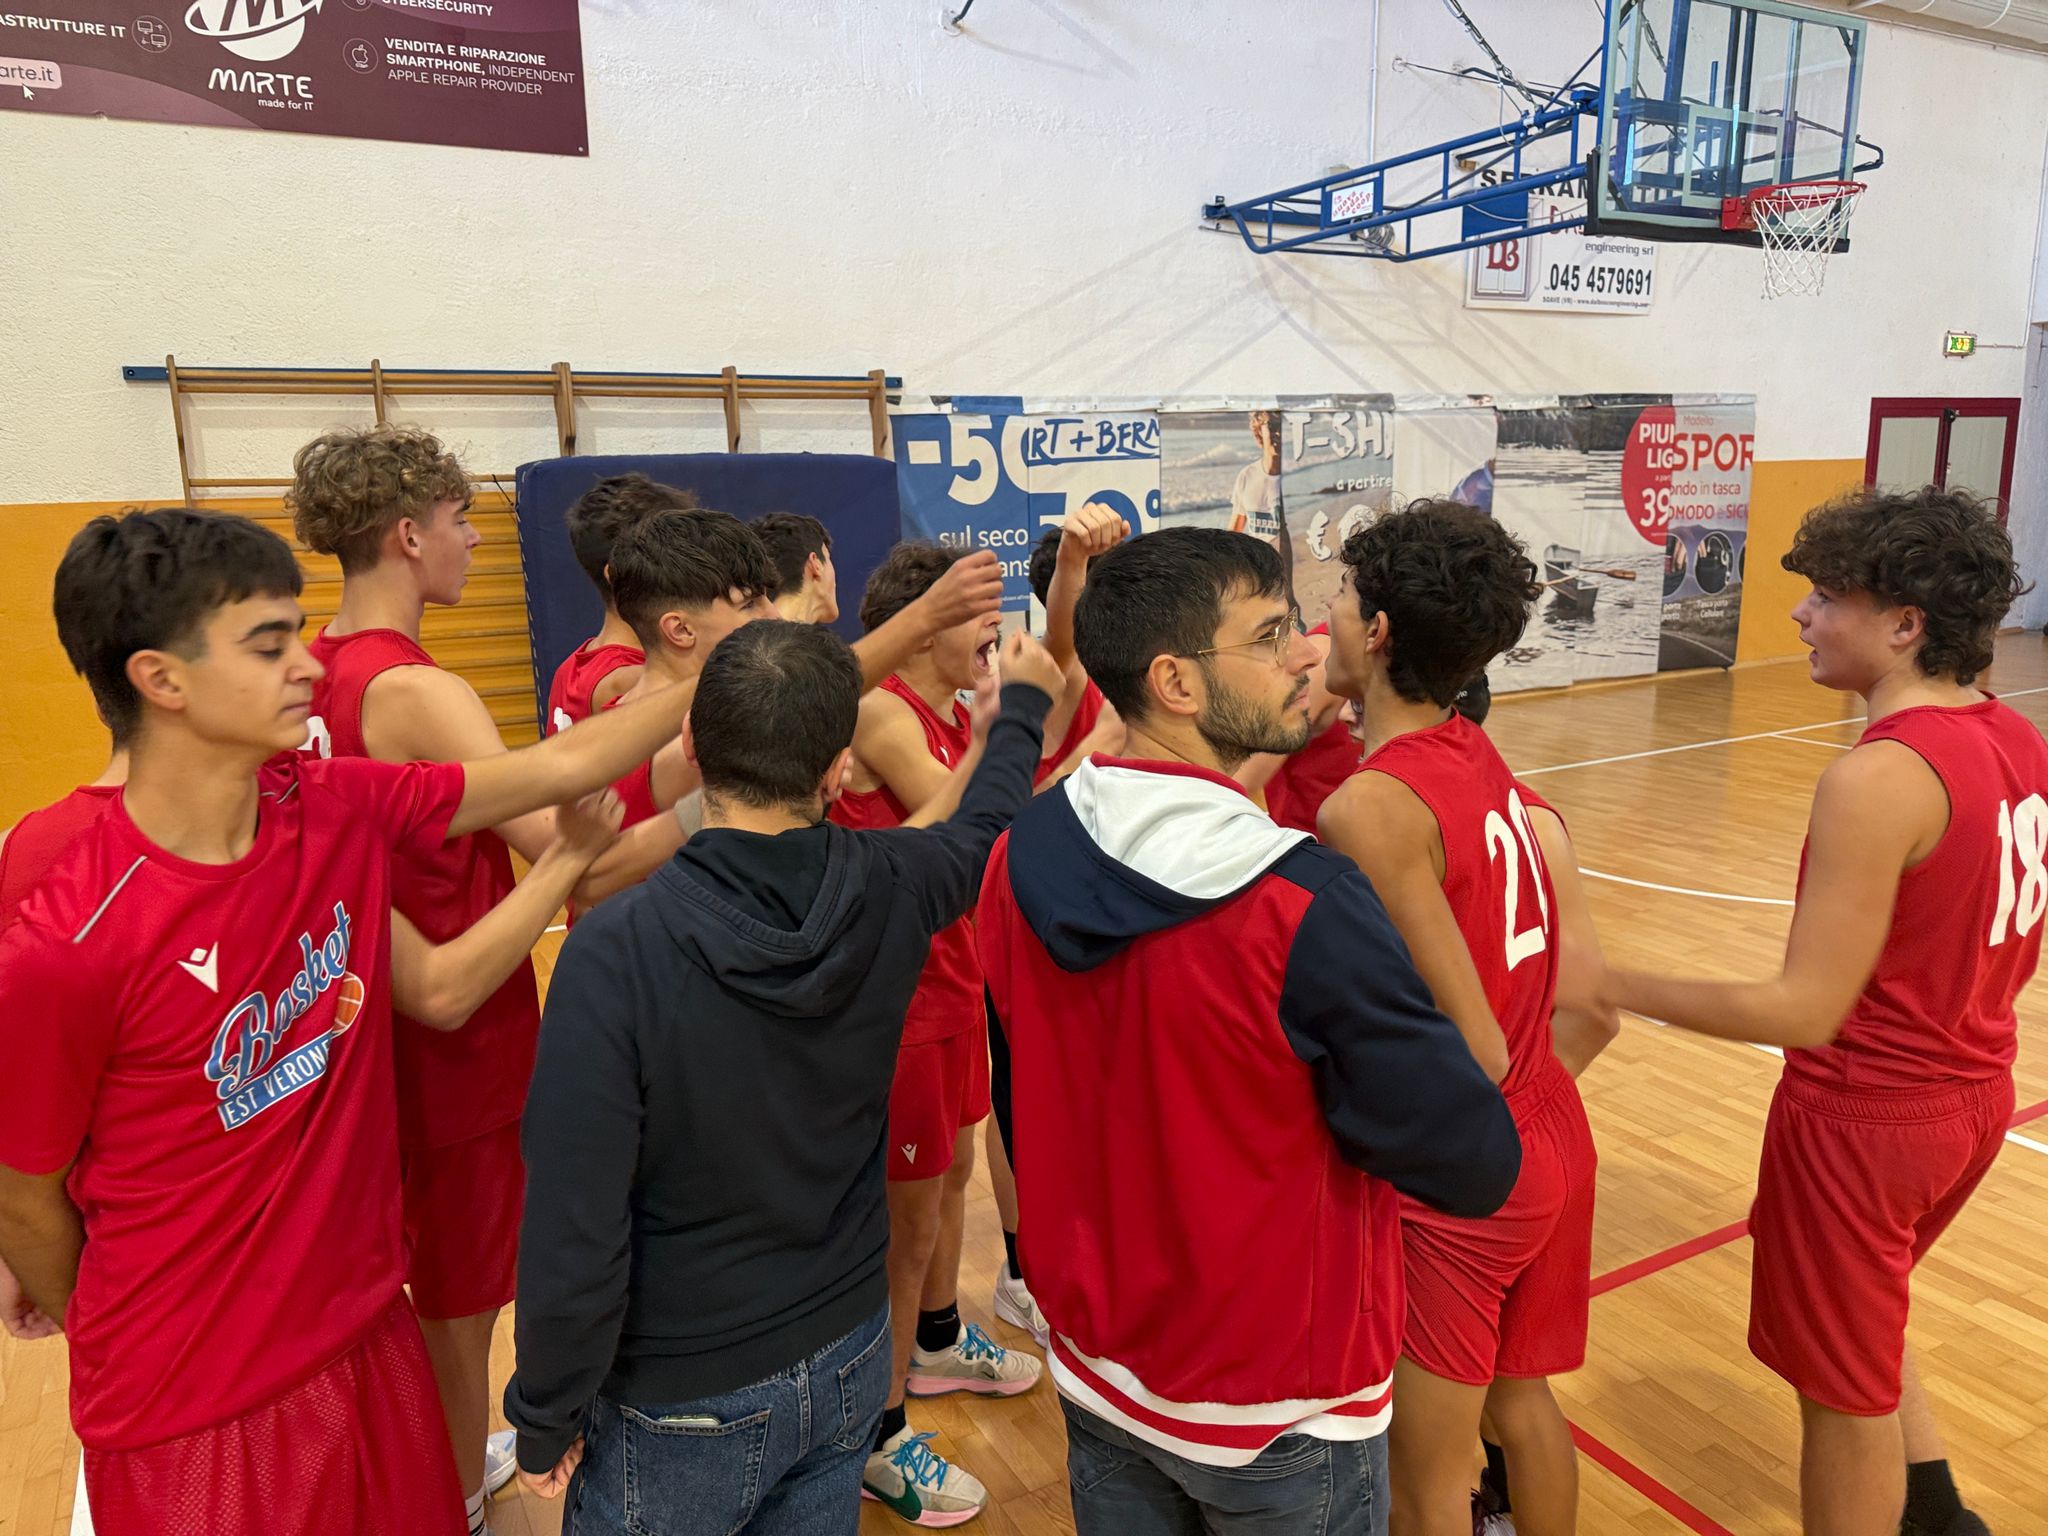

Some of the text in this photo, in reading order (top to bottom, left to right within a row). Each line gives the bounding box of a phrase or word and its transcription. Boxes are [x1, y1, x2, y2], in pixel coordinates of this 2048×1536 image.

[110, 26, 126, 38] IT
[384, 37, 546, 66] VENDITA E RIPARAZIONE
[208, 68, 313, 98] MARTE
[386, 53, 575, 84] SMARTPHONE, INDEPENDENT
[388, 69, 543, 95] APPLE REPAIR PROVIDER
[258, 99, 314, 110] made for IT
[1585, 242, 1654, 256] engineering srl
[1550, 263, 1652, 295] 045 4579691
[1348, 474, 1392, 492] partire
[1700, 481, 1710, 494] in
[1713, 482, 1741, 495] tasca
[1640, 488, 1670, 527] 39
[979, 528, 1029, 547] seco
[1988, 793, 2048, 947] 18
[204, 900, 351, 1099] Basket
[226, 1088, 258, 1126] EST
